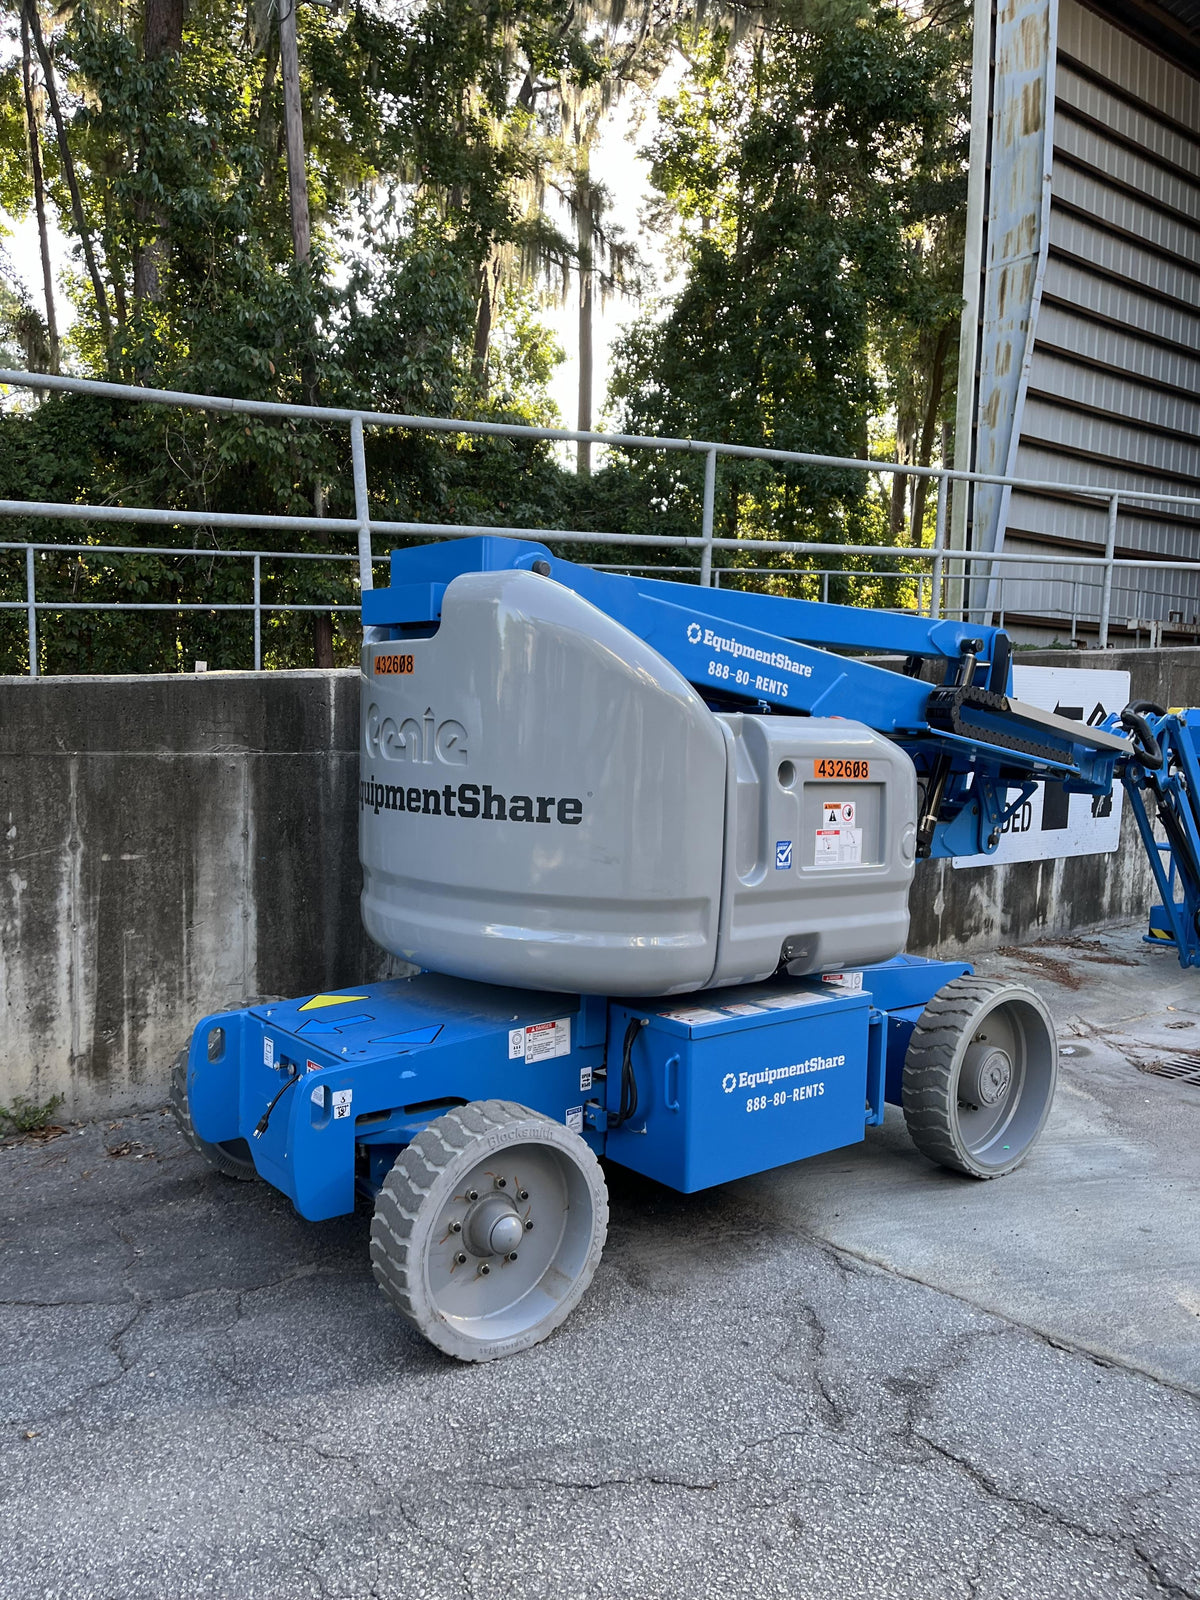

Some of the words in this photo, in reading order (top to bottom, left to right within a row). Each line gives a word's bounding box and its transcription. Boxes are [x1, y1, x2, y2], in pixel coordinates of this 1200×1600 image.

[376, 655, 413, 673] 432608
[703, 628, 813, 678] EquipmentShare
[707, 661, 789, 698] 888-80-RENTS
[818, 760, 868, 778] 432608
[738, 1055, 846, 1088] EquipmentShare
[746, 1082, 825, 1113] 888-80-RENTS
